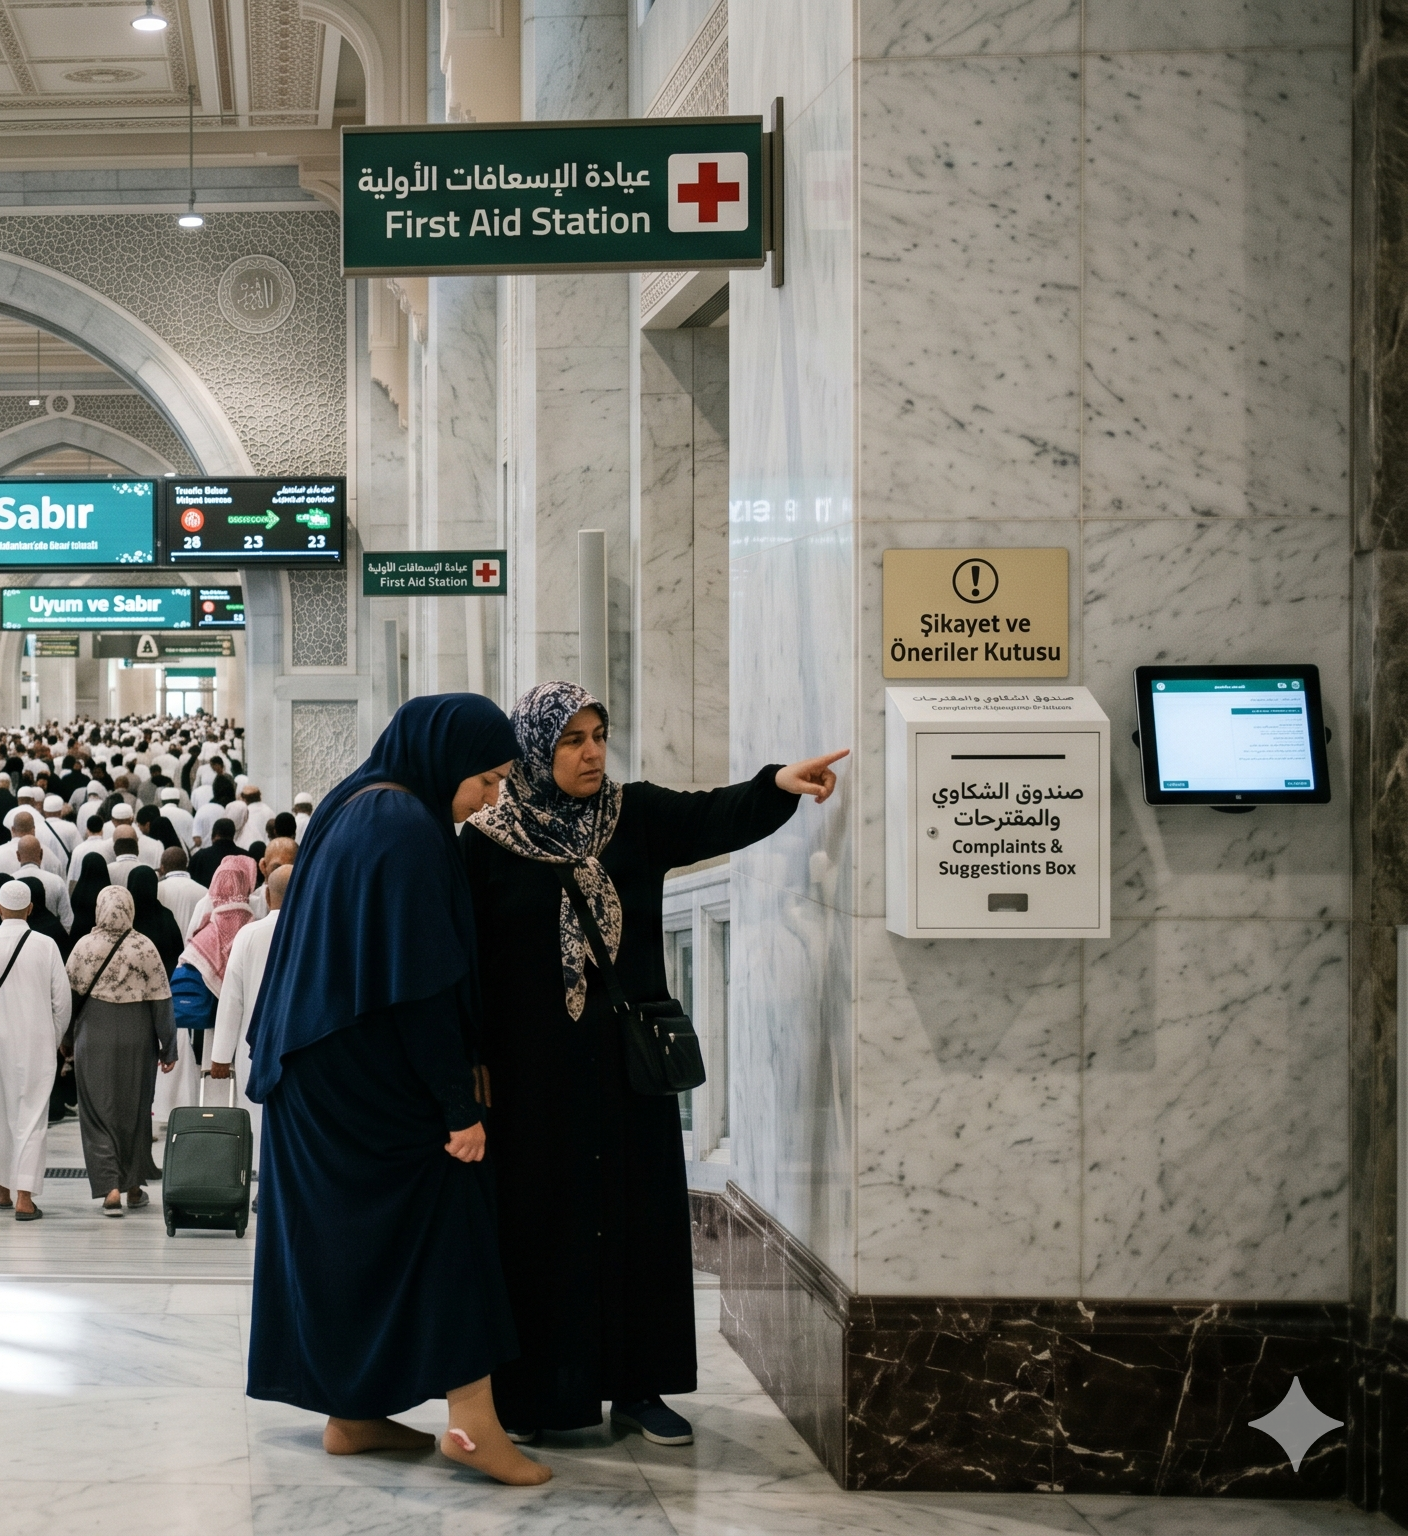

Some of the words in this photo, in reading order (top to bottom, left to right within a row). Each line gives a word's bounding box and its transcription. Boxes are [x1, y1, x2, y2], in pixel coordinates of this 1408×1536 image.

[358, 161, 437, 199] الأولية
[446, 162, 577, 196] الإسعافات
[585, 161, 650, 194] عيادة
[386, 209, 460, 239] First
[470, 208, 521, 237] Aid
[532, 206, 651, 236] Station
[243, 535, 264, 549] 23
[307, 535, 326, 548] 23
[380, 577, 405, 587] First
[407, 577, 426, 587] Aid
[428, 576, 468, 587] Station
[30, 596, 83, 616] Uyum
[87, 599, 109, 612] ve
[114, 595, 162, 612] Sabır
[920, 614, 1000, 637] Şikayet
[1006, 618, 1031, 632] ve
[891, 638, 978, 662] Öneriler
[984, 642, 1061, 661] Kutusu
[932, 782, 1009, 809] الشكاوي
[1016, 784, 1084, 805] صندوق
[954, 808, 1061, 832] والمقترحات
[952, 839, 1047, 857] Complaints
[1050, 839, 1063, 853] &
[939, 861, 1041, 878] Suggestions
[1045, 861, 1076, 875] Box
